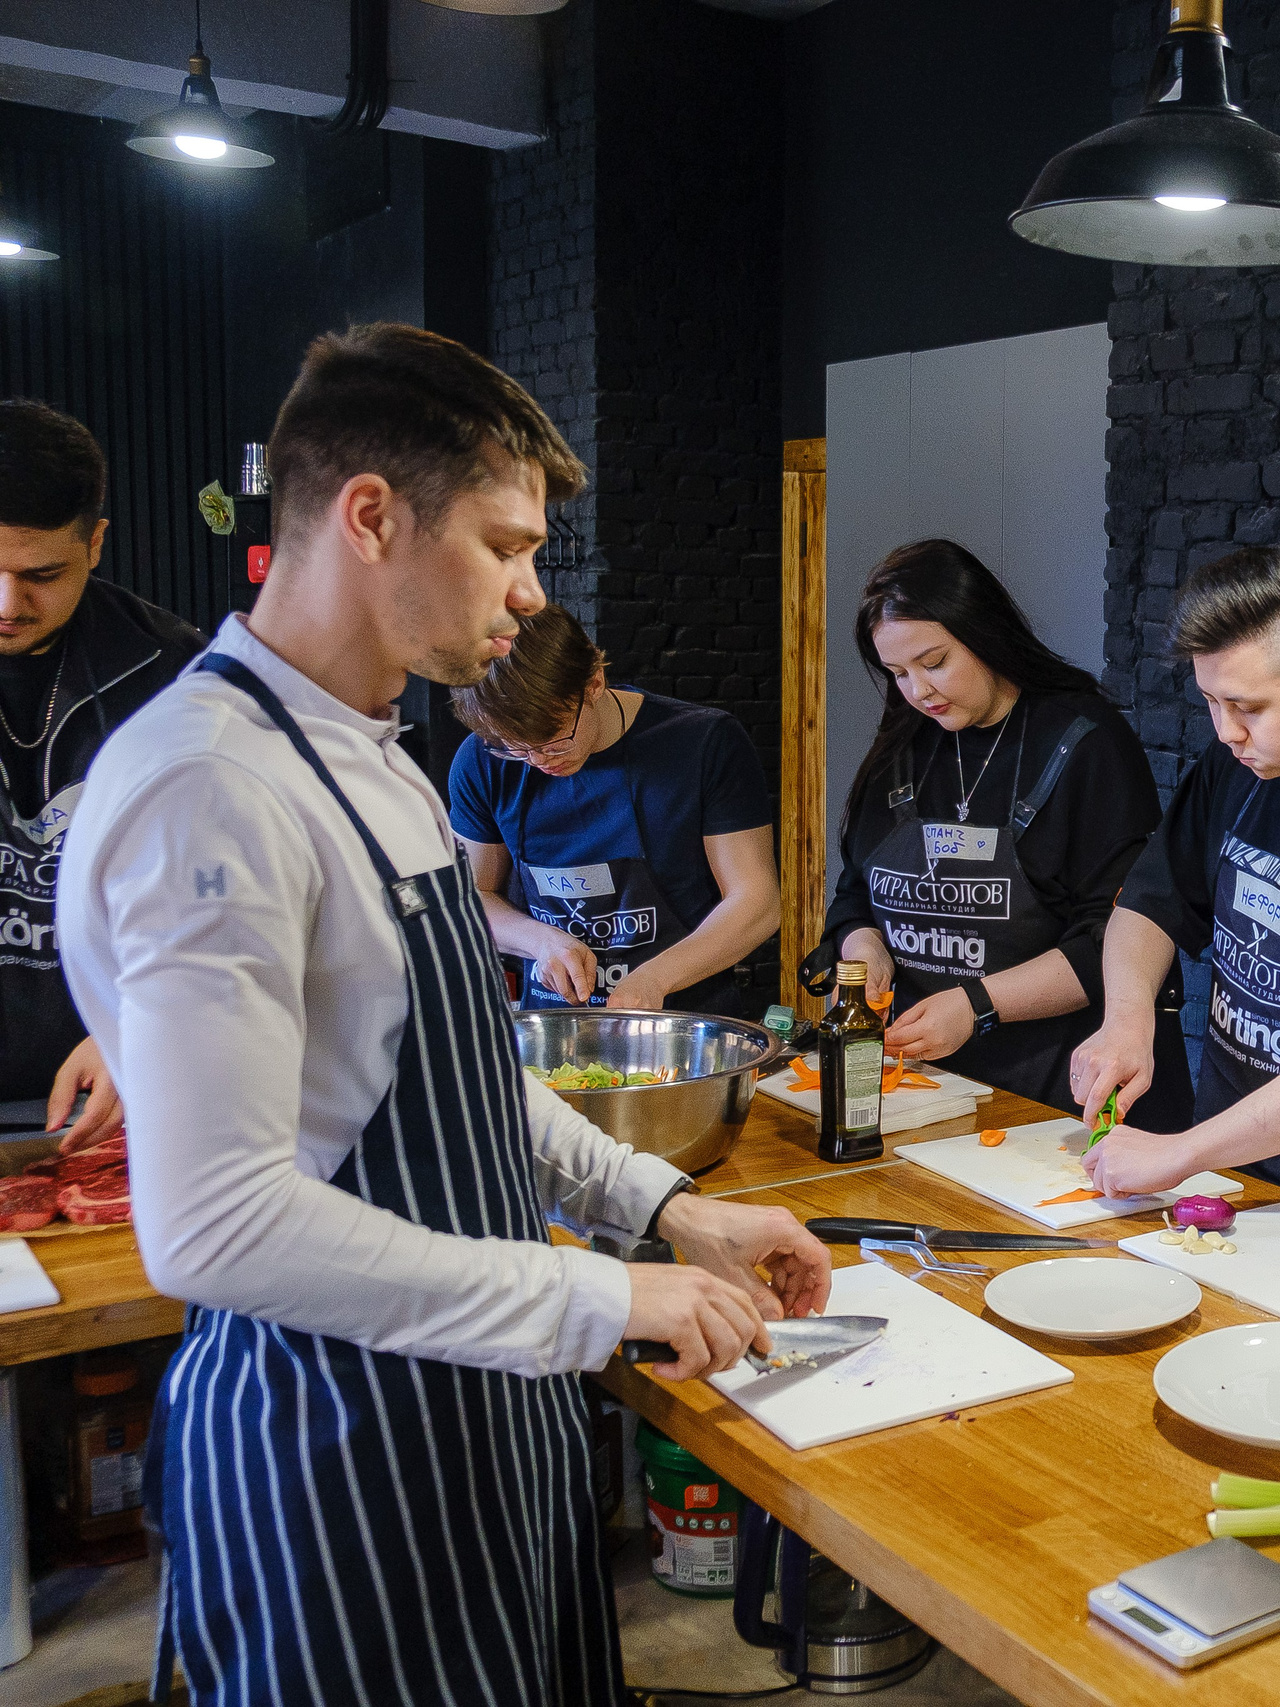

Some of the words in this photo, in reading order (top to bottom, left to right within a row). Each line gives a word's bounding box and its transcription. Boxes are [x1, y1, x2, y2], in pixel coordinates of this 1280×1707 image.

[873, 872, 912, 900] ИГРА
[915, 881, 1003, 905] СТОЛОВ
[941, 905, 976, 914] СТУДИЯ
[885, 921, 985, 969] körting
[949, 966, 986, 978] техника
